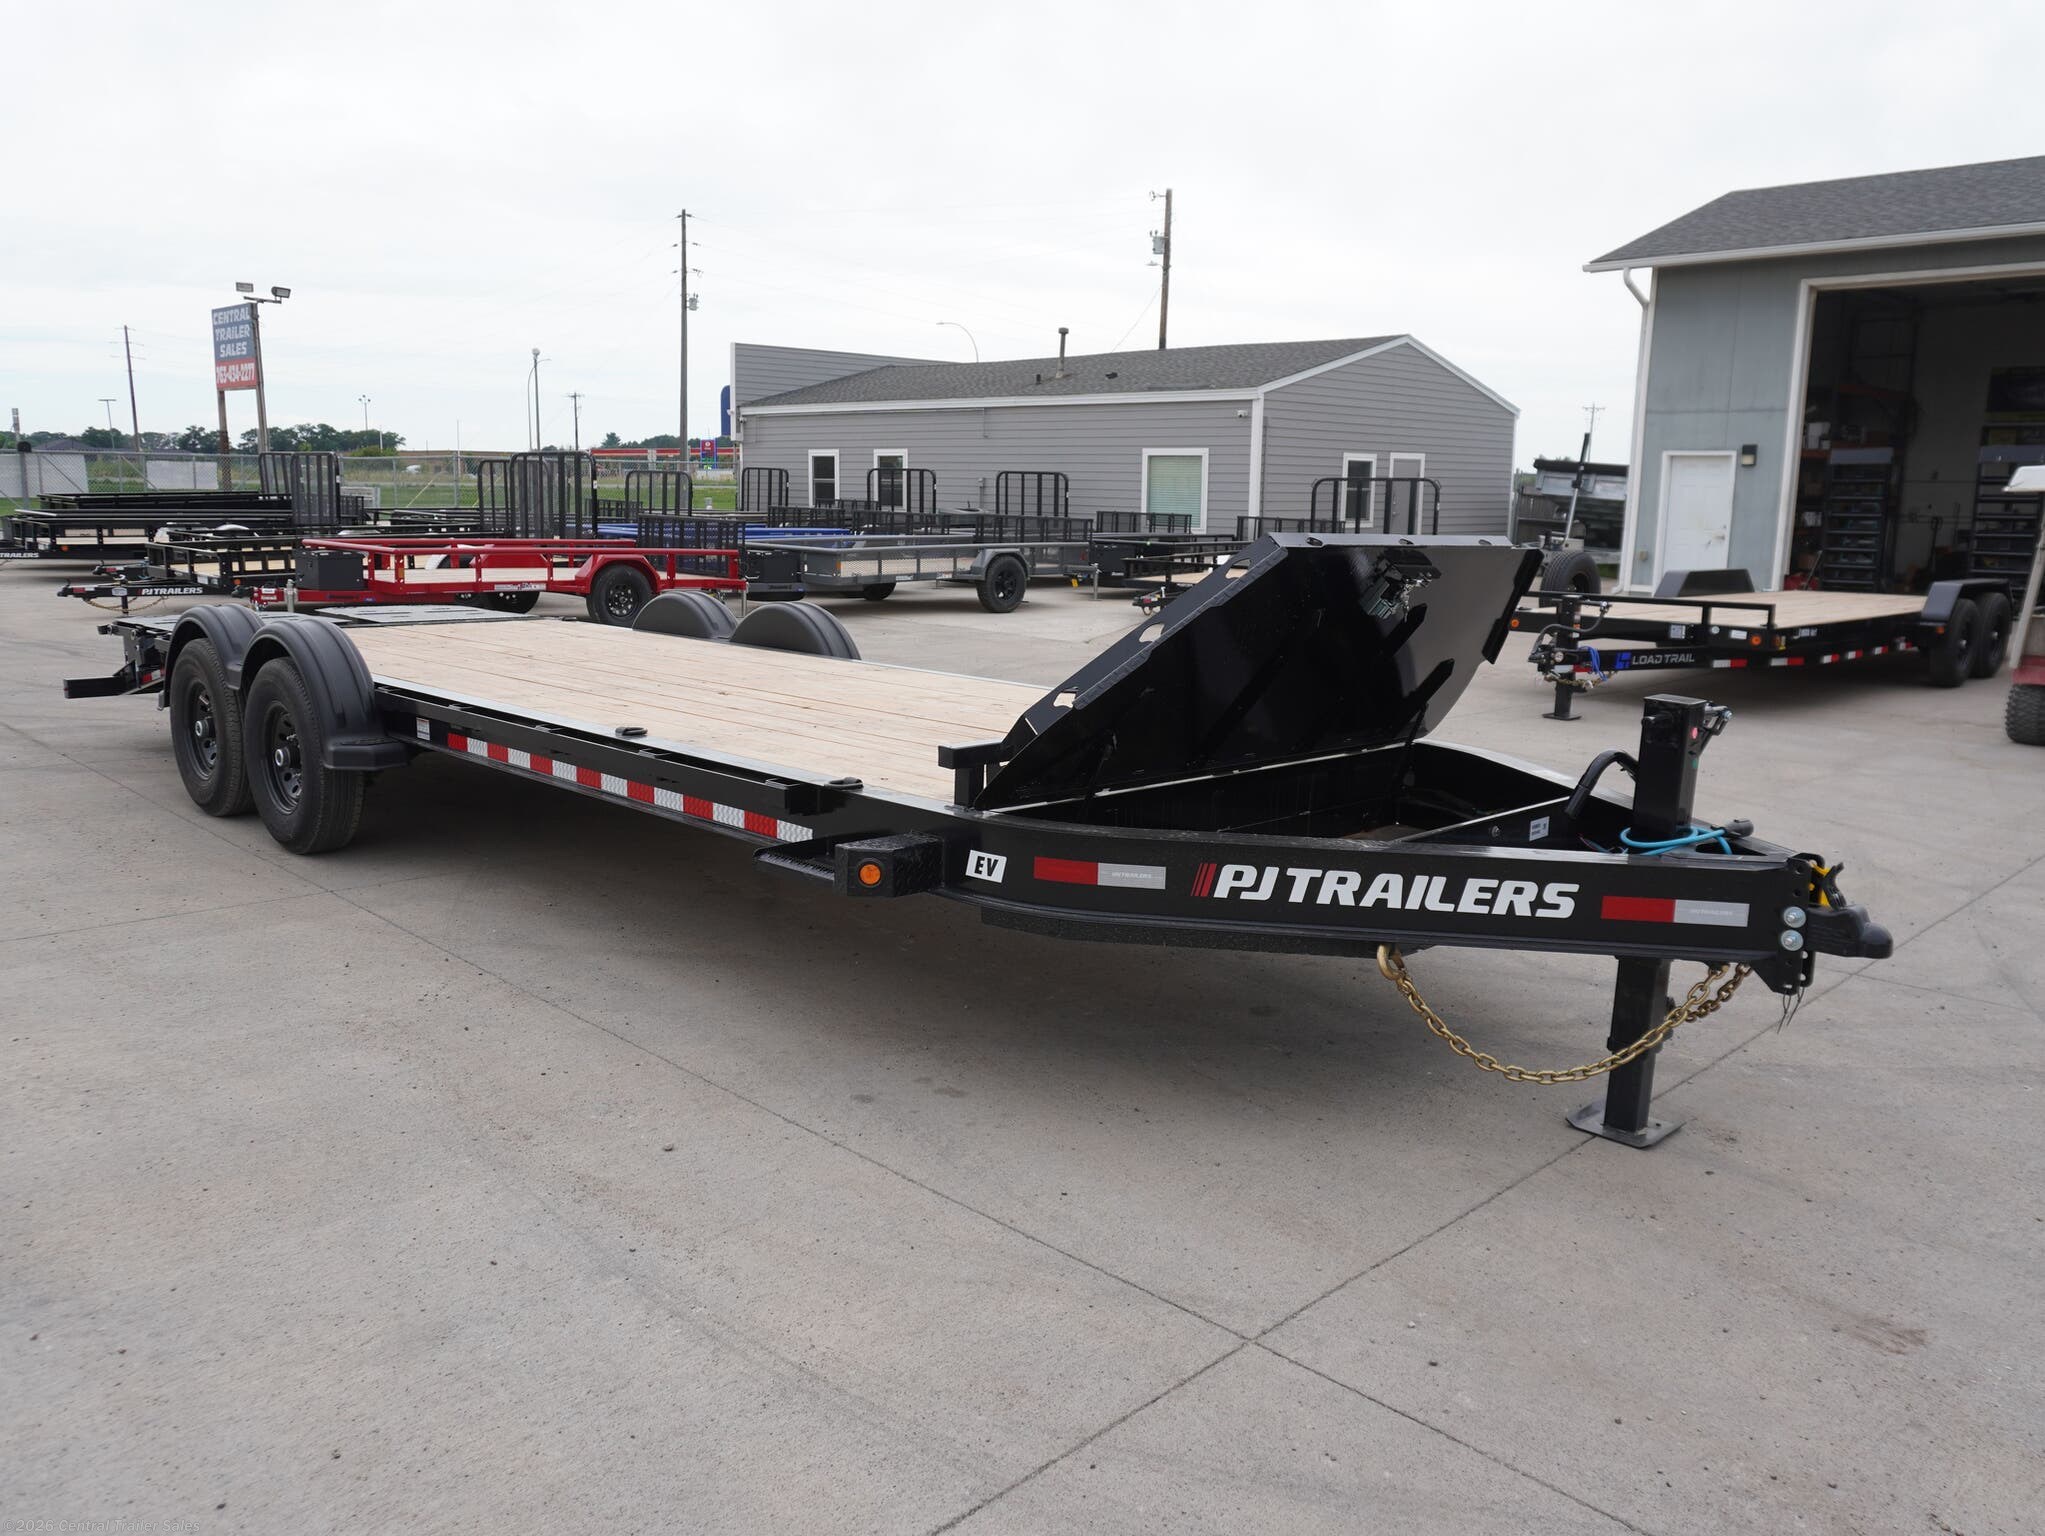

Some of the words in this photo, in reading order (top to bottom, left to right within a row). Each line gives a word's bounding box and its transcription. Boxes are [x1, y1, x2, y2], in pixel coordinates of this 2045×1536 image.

[213, 307, 250, 326] CENTRAL
[215, 324, 250, 341] TRAILER
[220, 341, 248, 358] SALES
[154, 587, 204, 595] TRAILERS
[1632, 655, 1662, 665] LOAD
[1664, 653, 1695, 663] TRAIL
[974, 855, 999, 878] EV
[1214, 864, 1279, 901] PJ
[1286, 868, 1580, 919] TRAILERS
